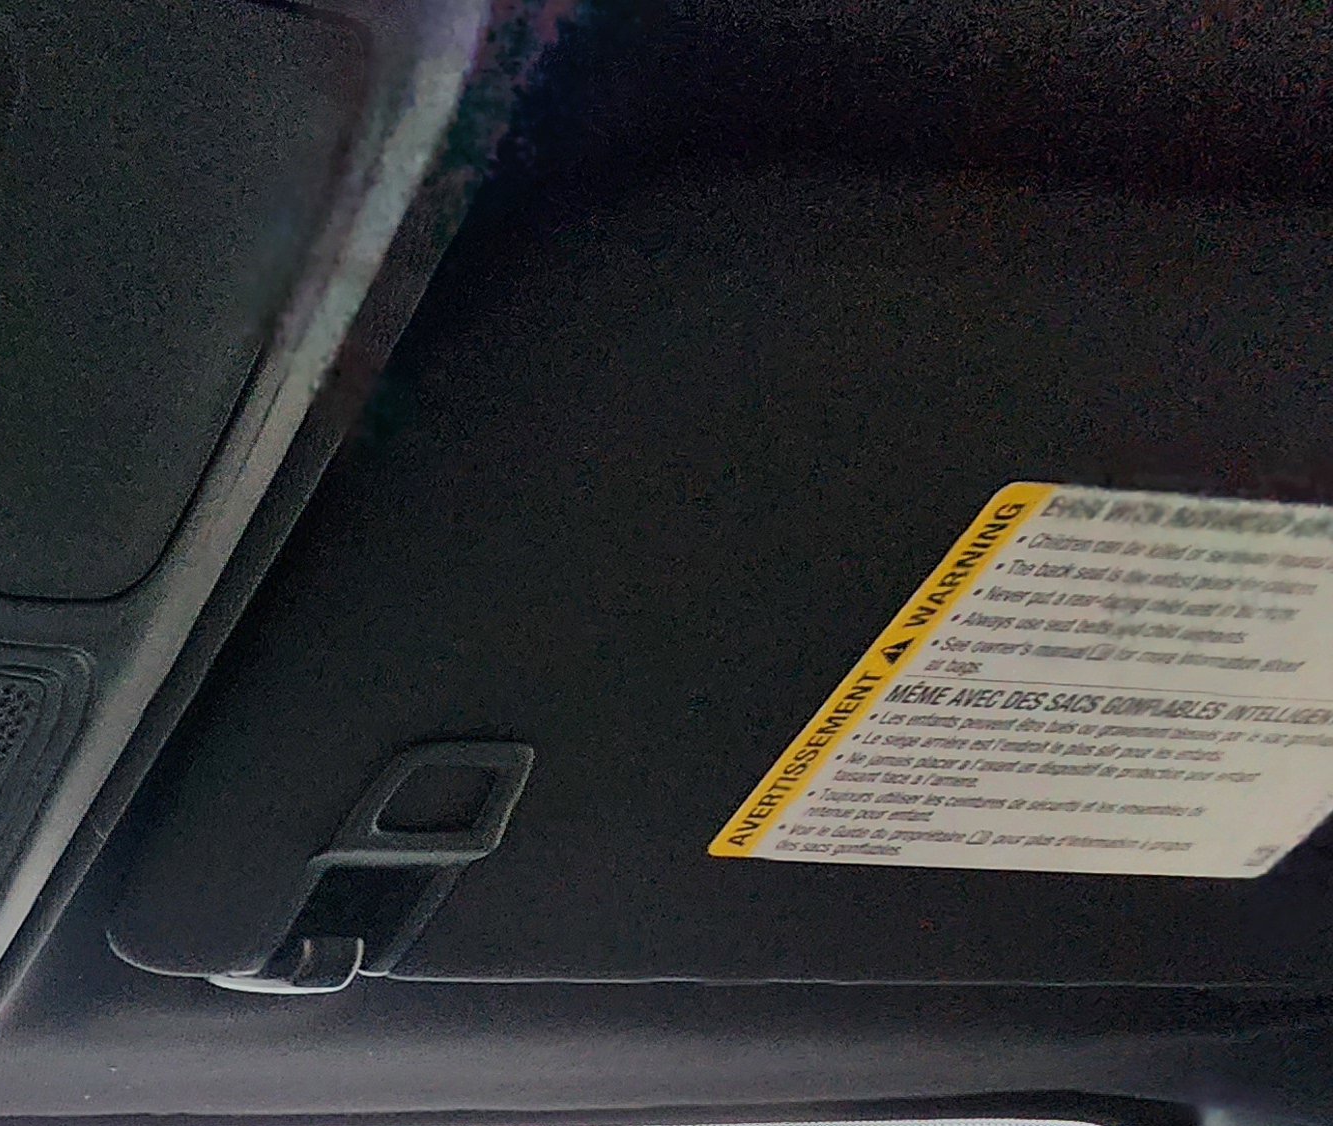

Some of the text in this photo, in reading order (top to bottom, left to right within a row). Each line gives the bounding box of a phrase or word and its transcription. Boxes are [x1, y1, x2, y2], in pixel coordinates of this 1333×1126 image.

[727, 670, 883, 848] AVERTISSEMENT
[902, 502, 1026, 628] WARNING
[945, 686, 1005, 710] AVEC
[1000, 690, 1050, 712] DES
[1044, 692, 1106, 716] SACS
